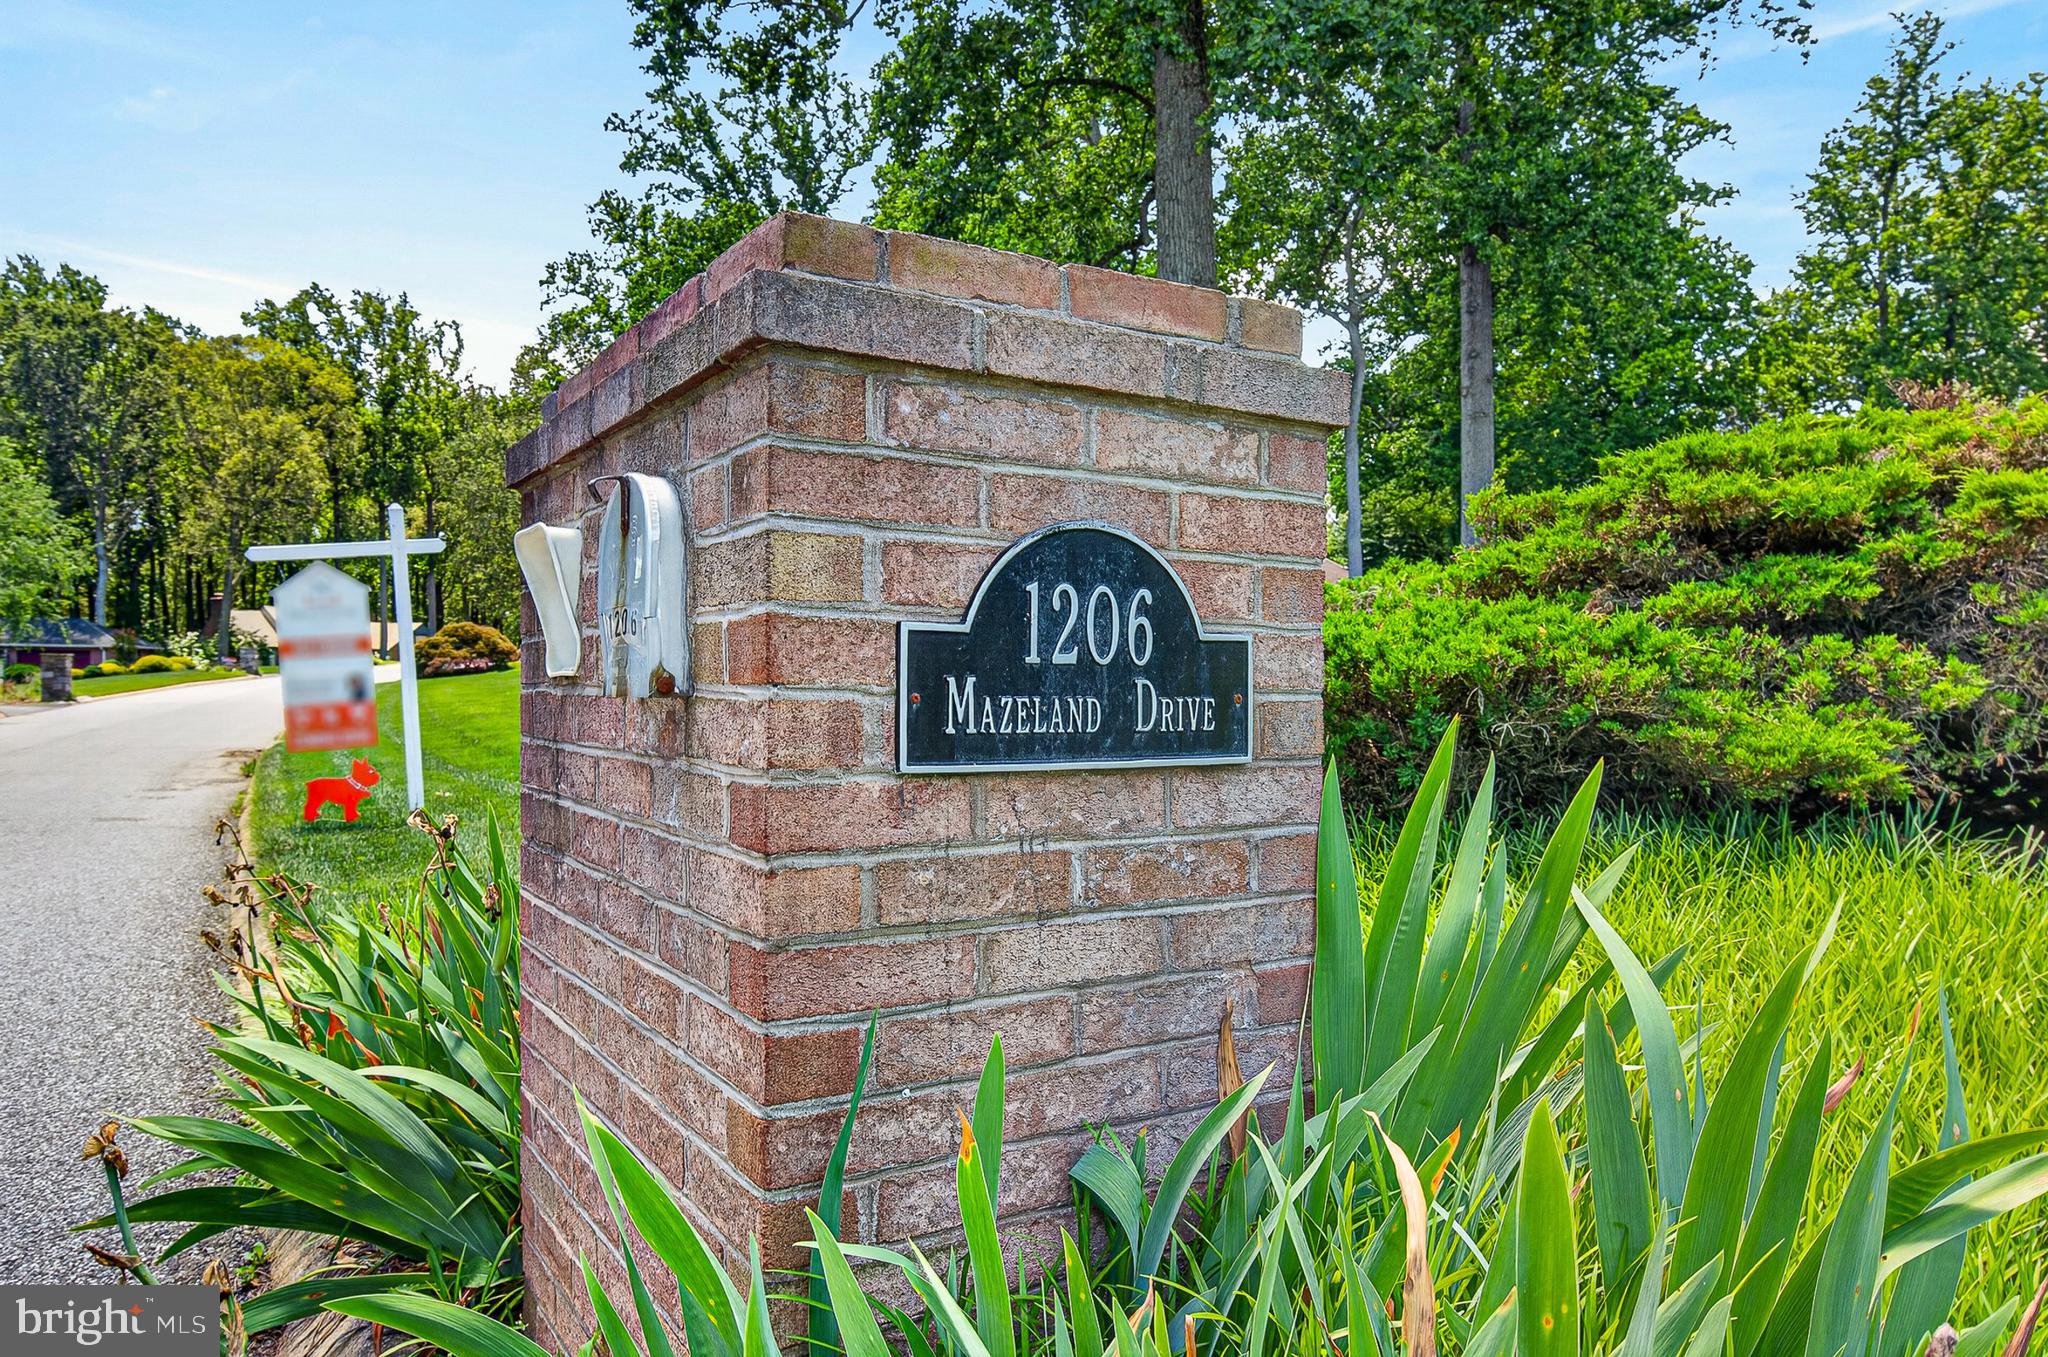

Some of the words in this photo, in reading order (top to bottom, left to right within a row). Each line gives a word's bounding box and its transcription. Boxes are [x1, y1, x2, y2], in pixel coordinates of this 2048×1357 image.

[608, 607, 637, 640] 1206
[1024, 581, 1154, 667] 1206
[944, 675, 1102, 735] MAZELAND
[1134, 678, 1216, 733] DRIVE
